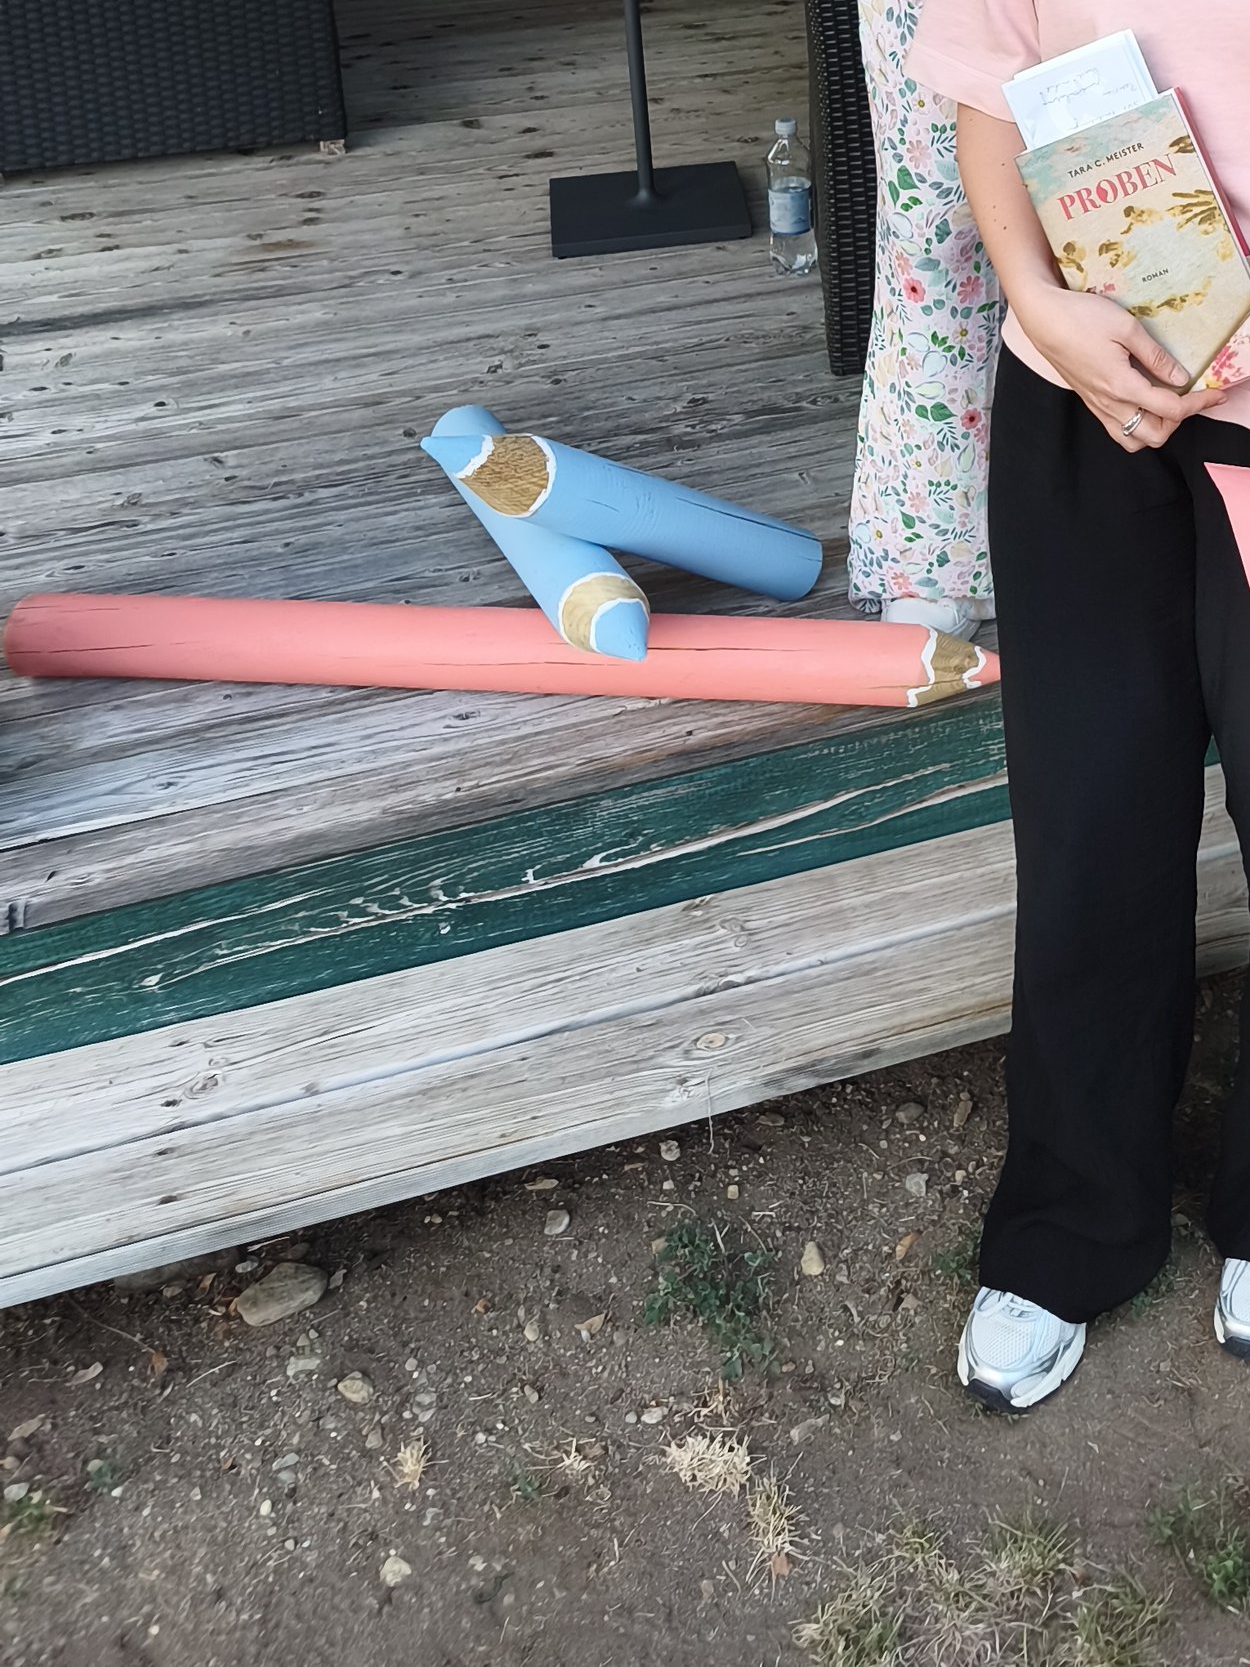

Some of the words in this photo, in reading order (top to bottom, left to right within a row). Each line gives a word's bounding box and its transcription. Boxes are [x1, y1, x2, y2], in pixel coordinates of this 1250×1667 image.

[1067, 161, 1093, 179] TARA
[1105, 141, 1145, 164] MEISTER
[1056, 154, 1177, 221] PROBEN
[1141, 267, 1170, 283] ROMAN
